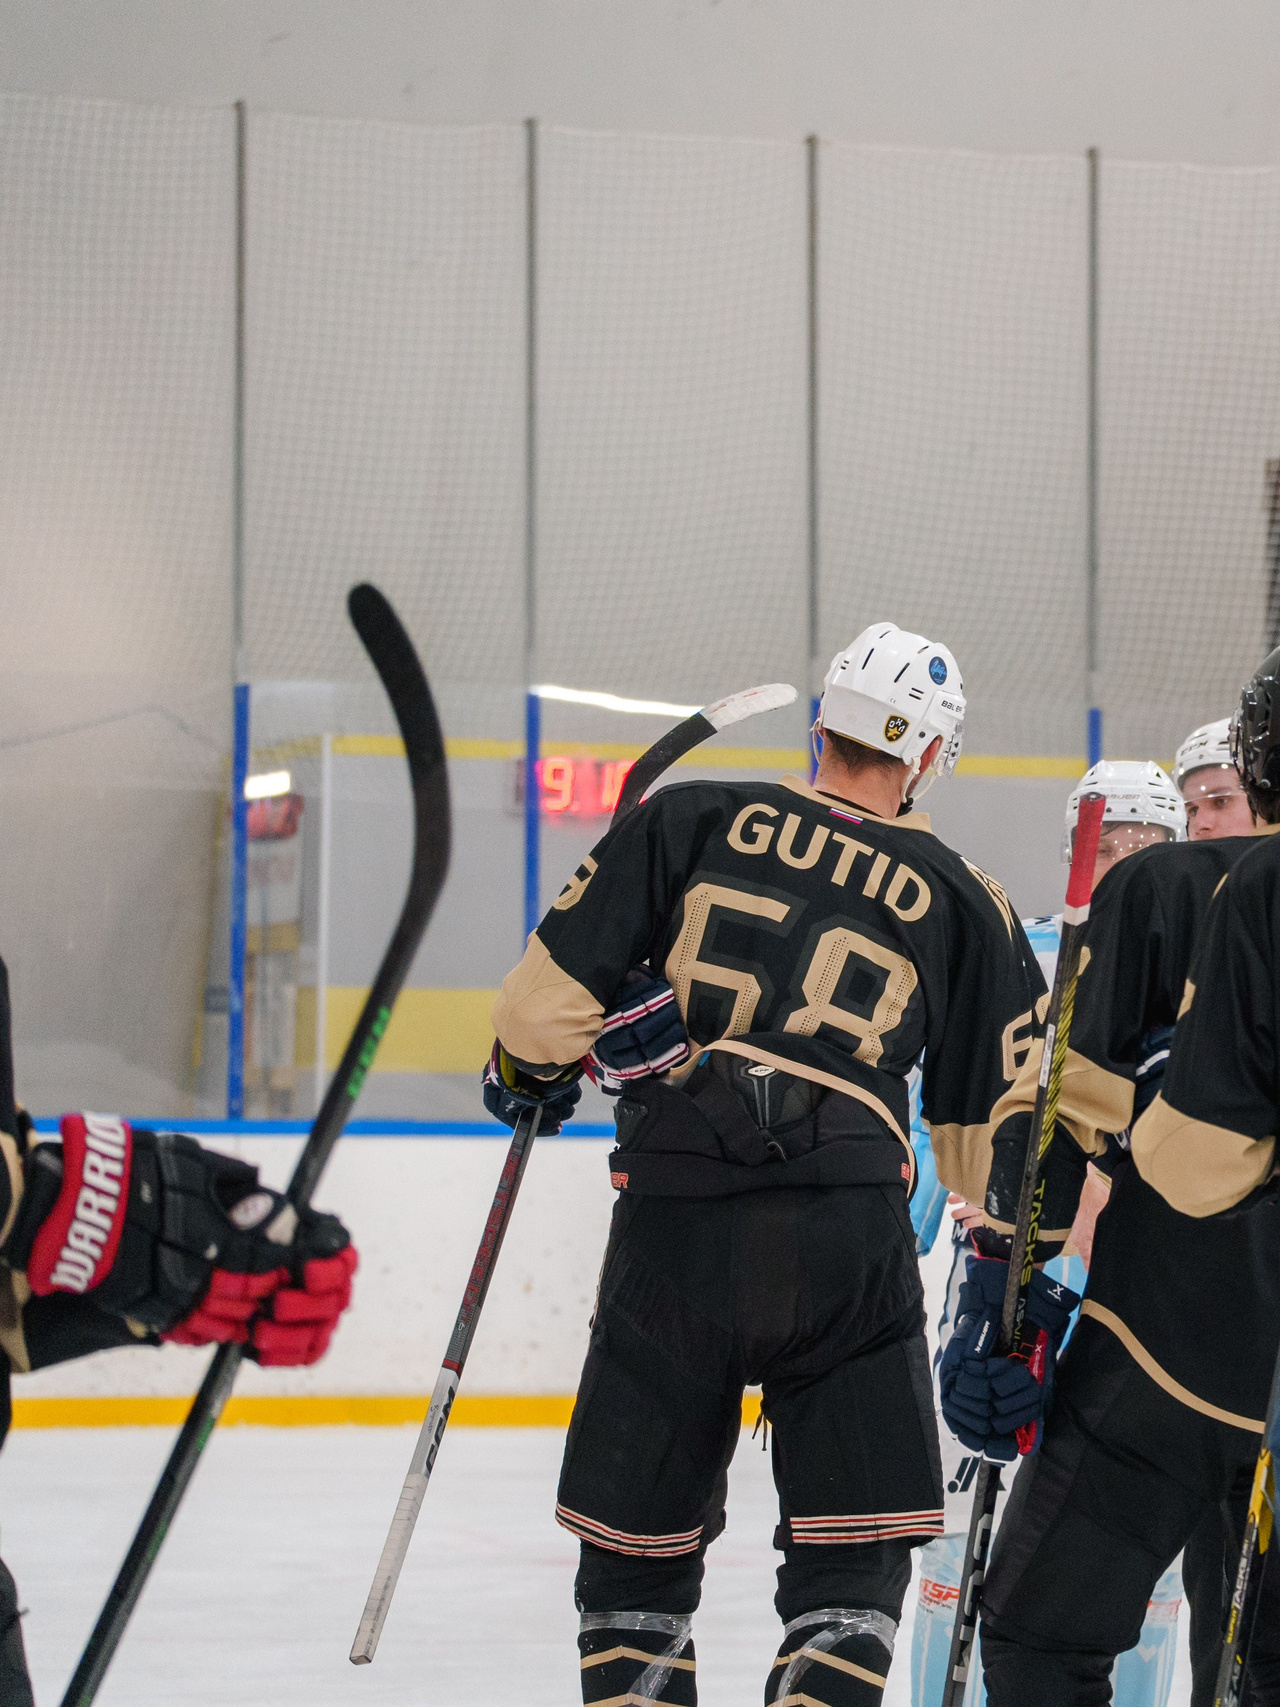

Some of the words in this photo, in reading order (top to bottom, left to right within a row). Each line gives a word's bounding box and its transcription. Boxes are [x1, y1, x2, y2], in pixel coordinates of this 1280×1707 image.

[726, 803, 932, 922] GUTID
[664, 881, 919, 1068] 68
[1020, 1178, 1045, 1286] TACKS
